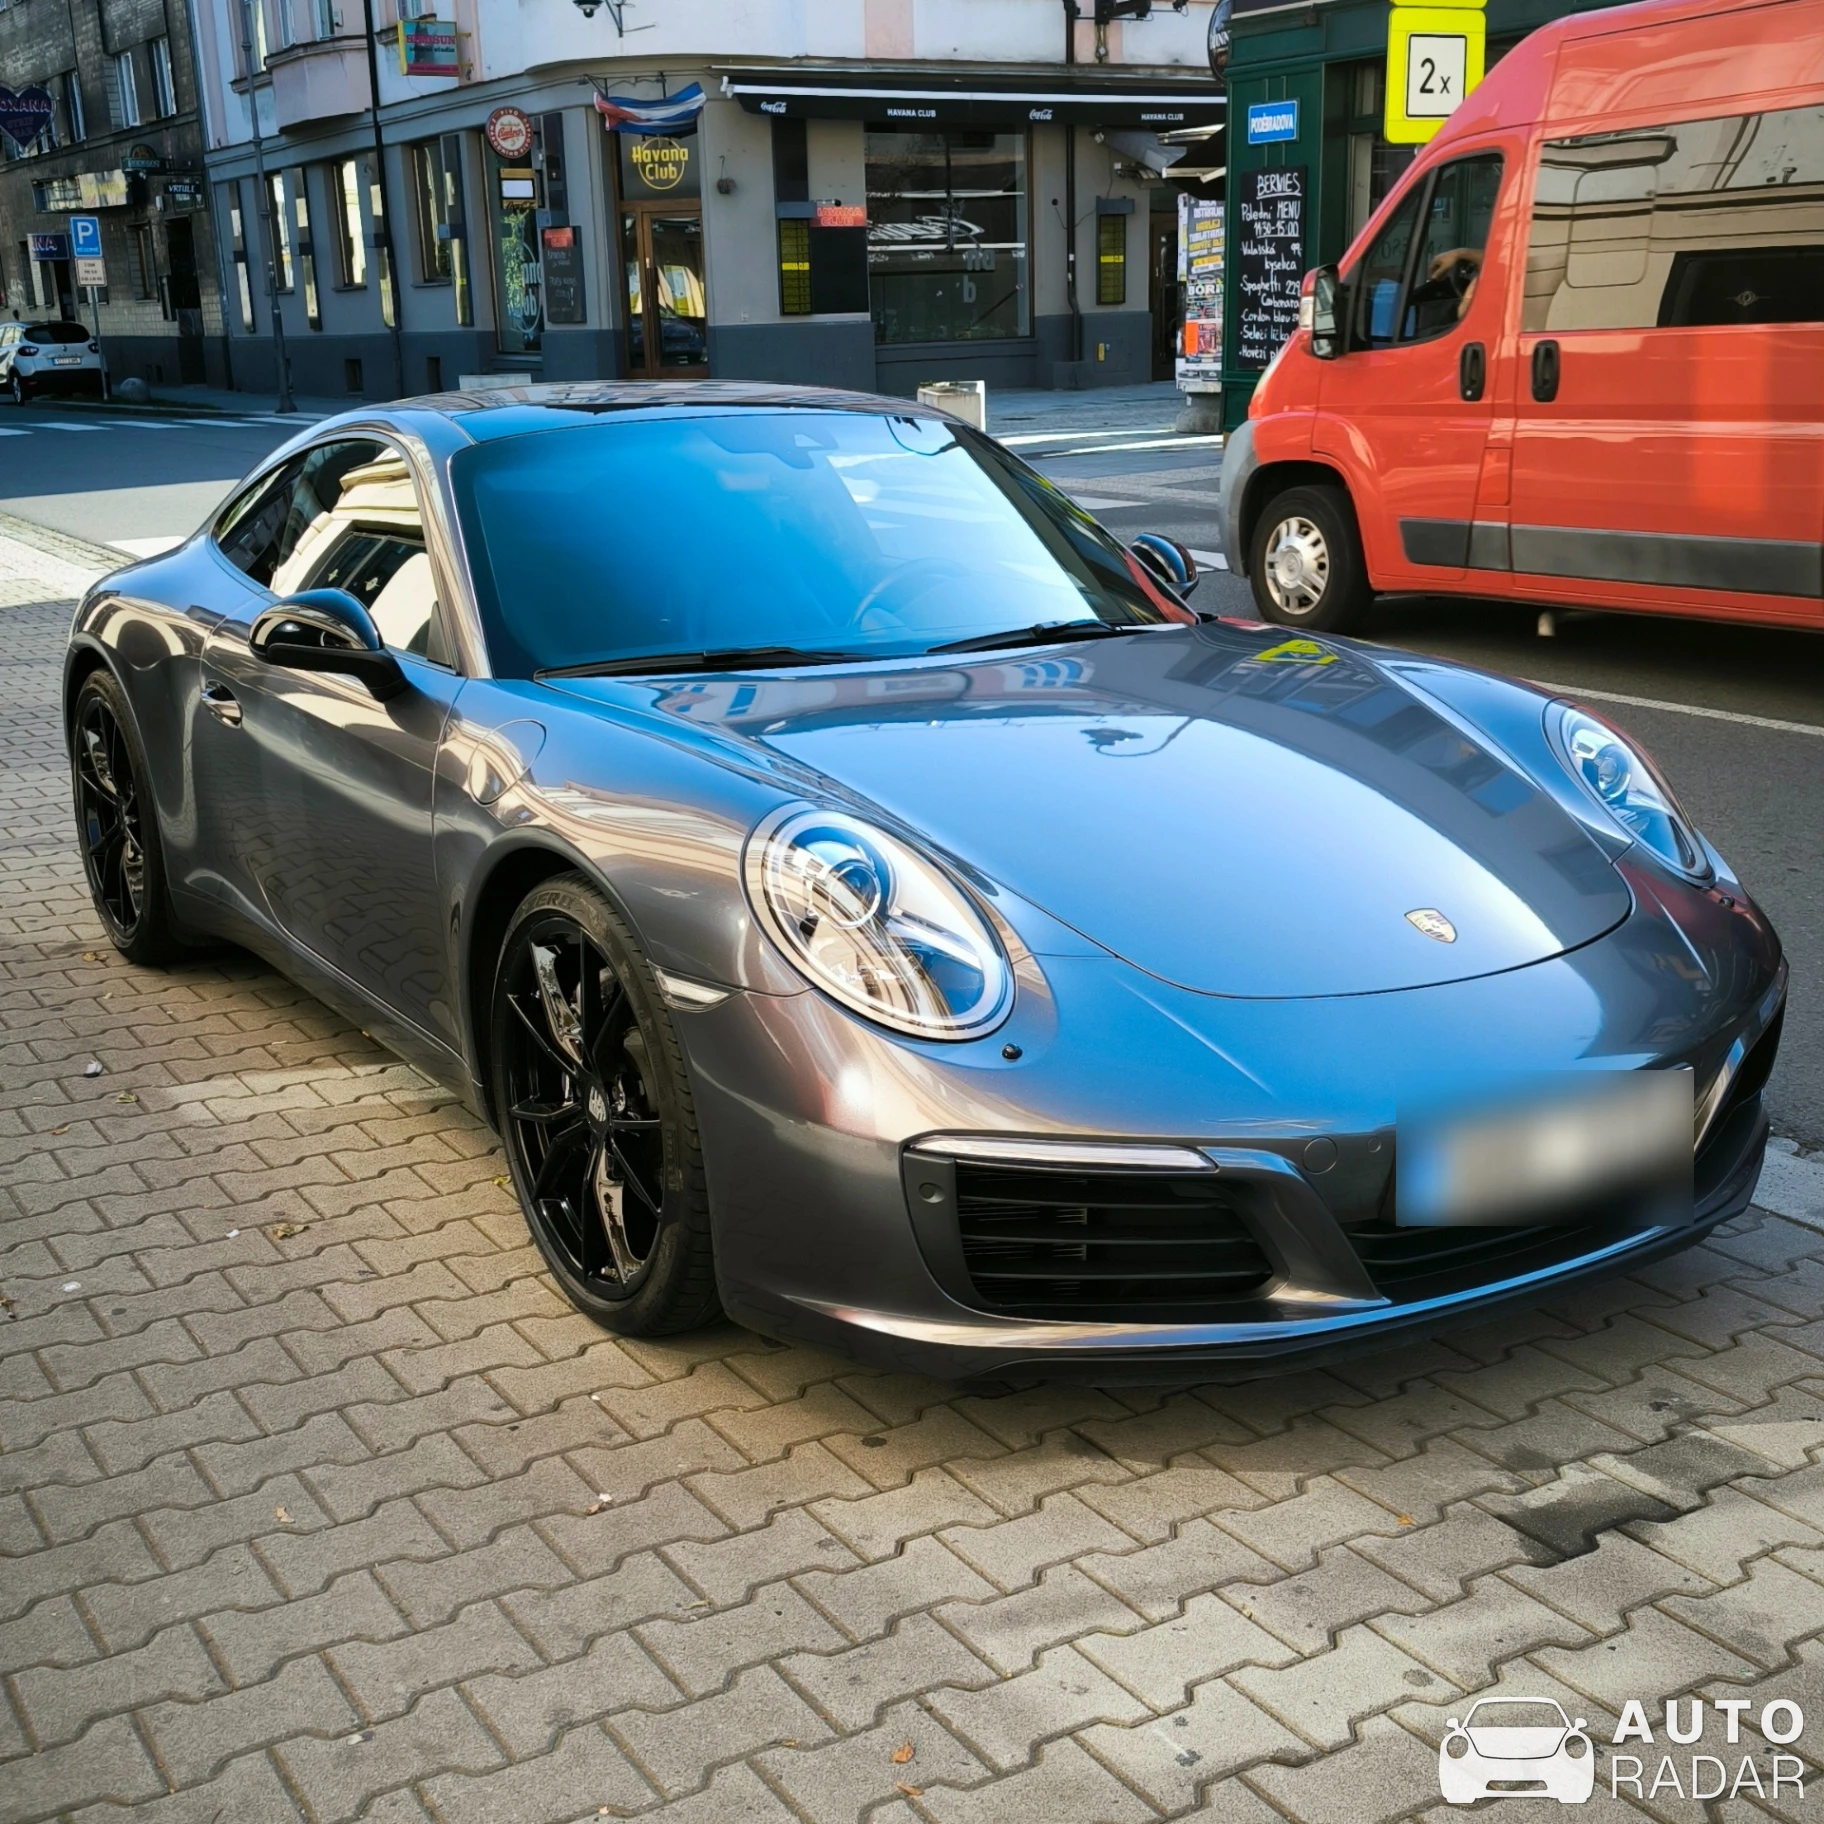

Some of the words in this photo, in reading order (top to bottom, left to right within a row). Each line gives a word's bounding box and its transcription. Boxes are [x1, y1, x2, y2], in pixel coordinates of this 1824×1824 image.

[0, 99, 51, 112] OXANA
[887, 108, 917, 117] HAVANA
[917, 109, 937, 118] CLUB
[1141, 113, 1167, 121] HAVANA
[1167, 113, 1184, 121] CLUB
[632, 145, 689, 163] Havana
[645, 162, 678, 180] Club
[168, 184, 196, 193] VRTULE
[1241, 200, 1272, 221] Polední
[1277, 200, 1301, 220] MENU
[77, 221, 94, 245] P
